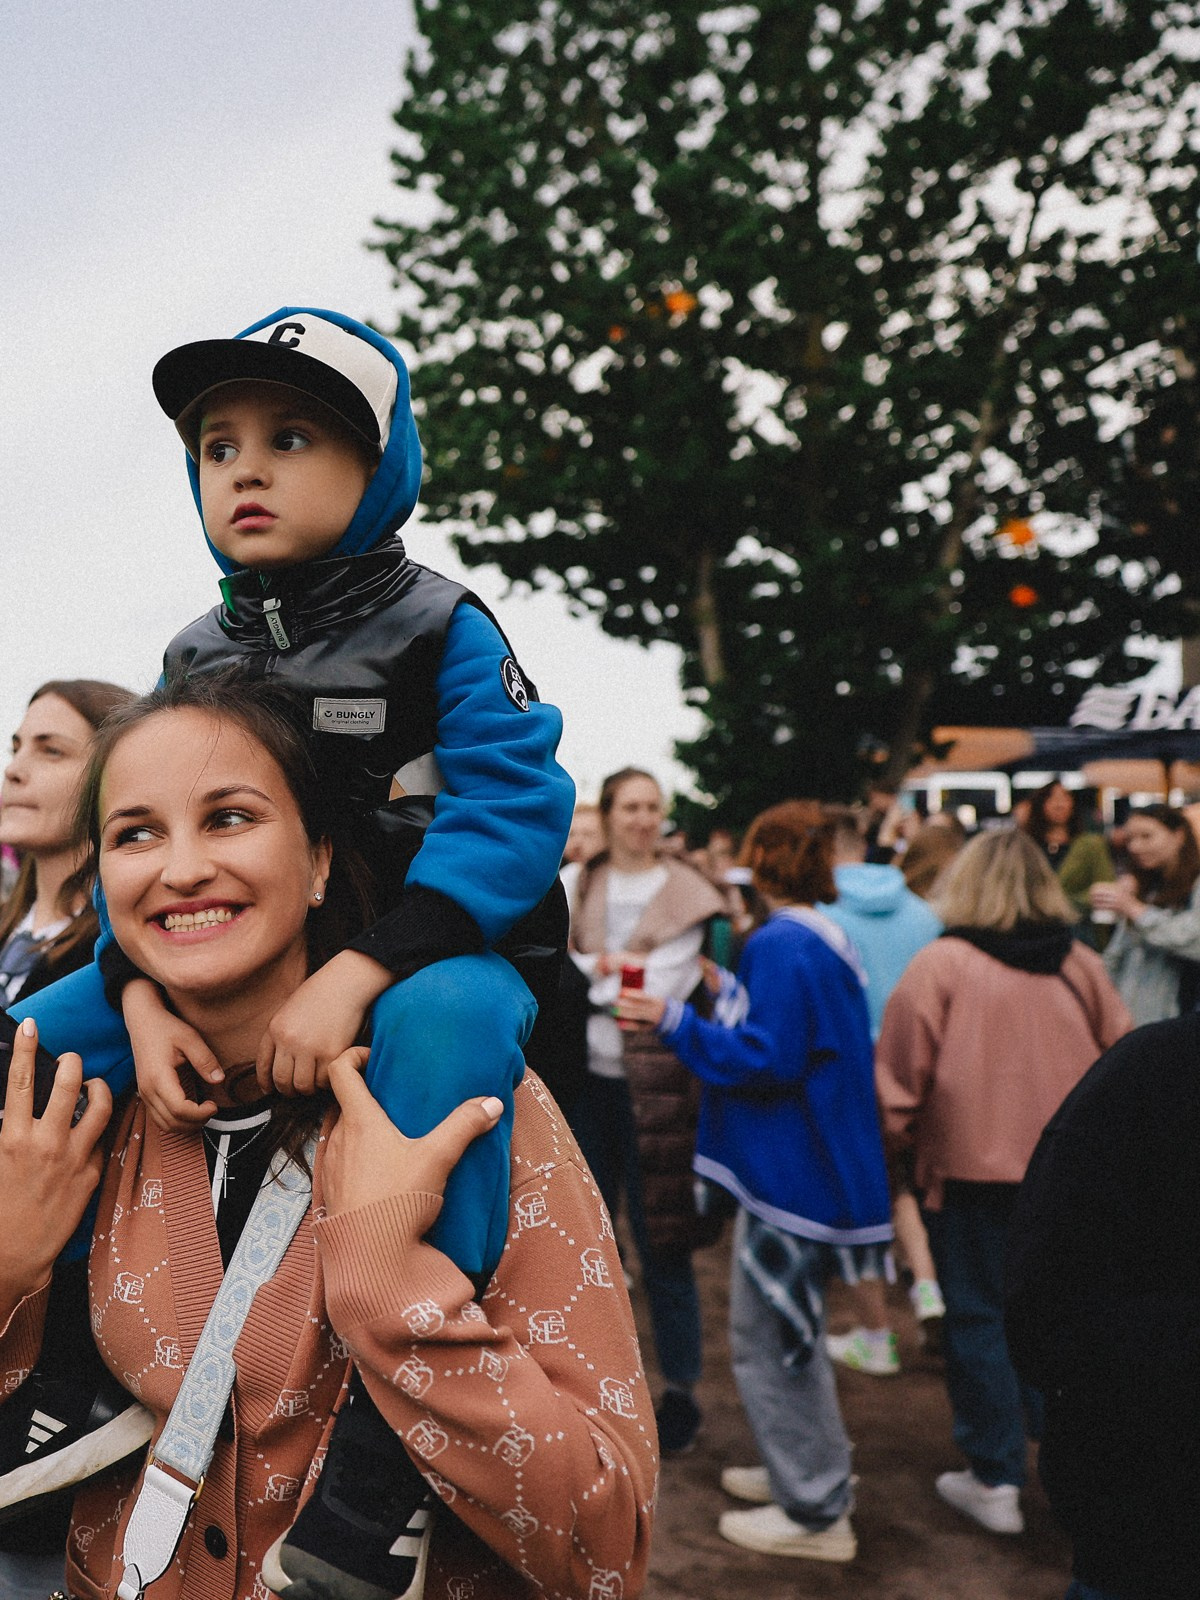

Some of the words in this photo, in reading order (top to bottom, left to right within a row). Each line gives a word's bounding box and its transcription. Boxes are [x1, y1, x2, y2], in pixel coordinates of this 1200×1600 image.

[268, 322, 306, 349] C
[270, 616, 285, 642] BUNGLY
[336, 711, 376, 719] BUNGLY
